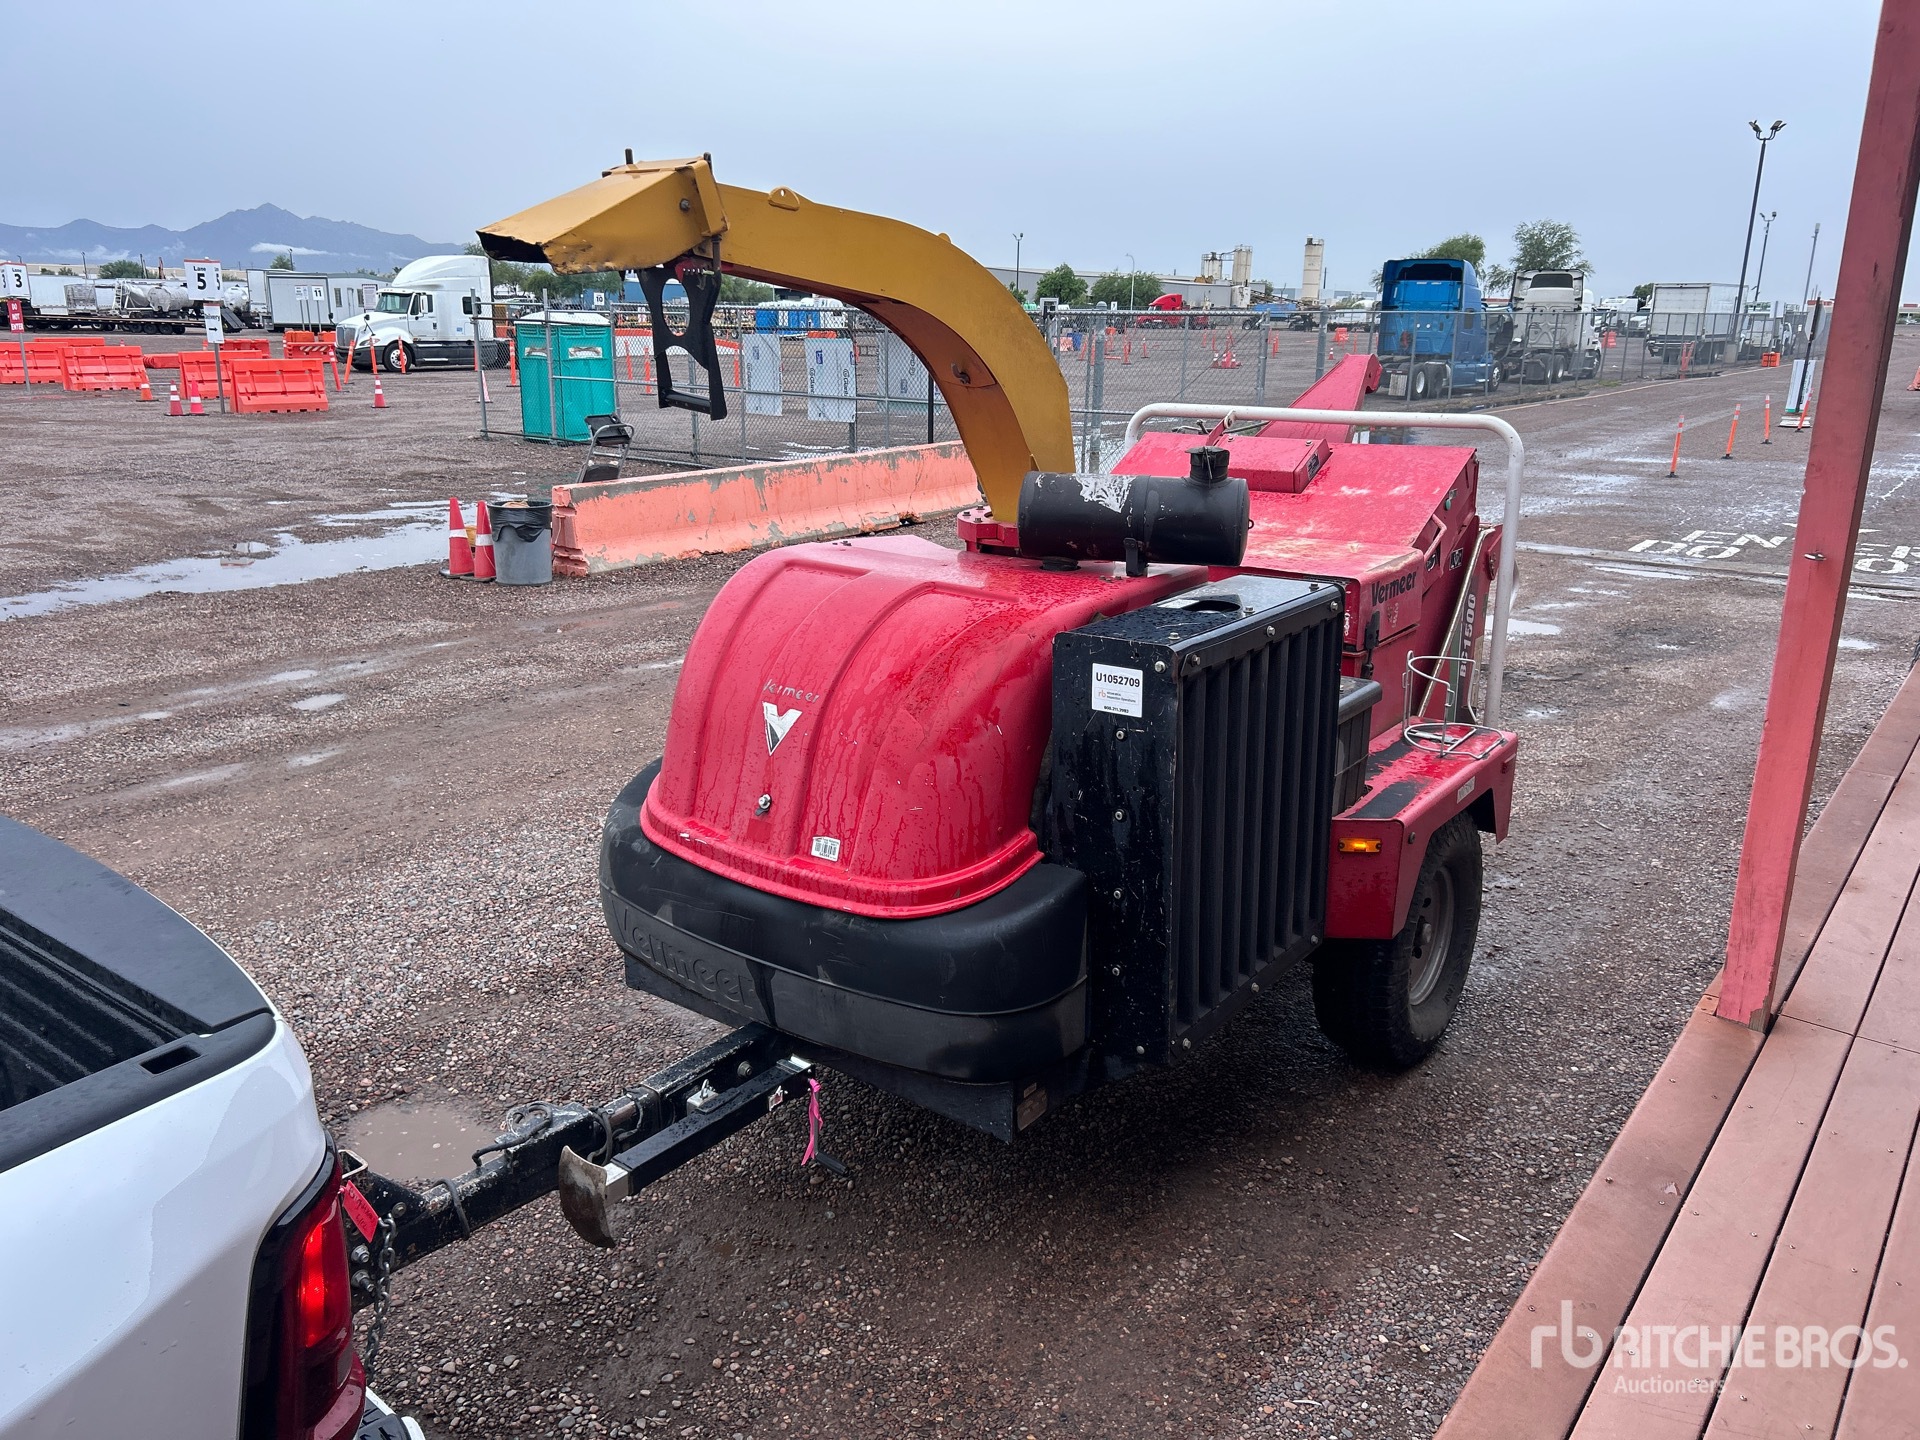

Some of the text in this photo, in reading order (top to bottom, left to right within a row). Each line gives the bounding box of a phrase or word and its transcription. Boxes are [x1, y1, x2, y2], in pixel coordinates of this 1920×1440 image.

[15, 274, 22, 288] 3
[197, 273, 206, 290] 5
[1628, 539, 1740, 559] DO
[1371, 571, 1417, 606] Vermeer
[1096, 672, 1140, 687] U1052709
[1098, 690, 1106, 698] rb
[608, 894, 755, 1010] Vermeer
